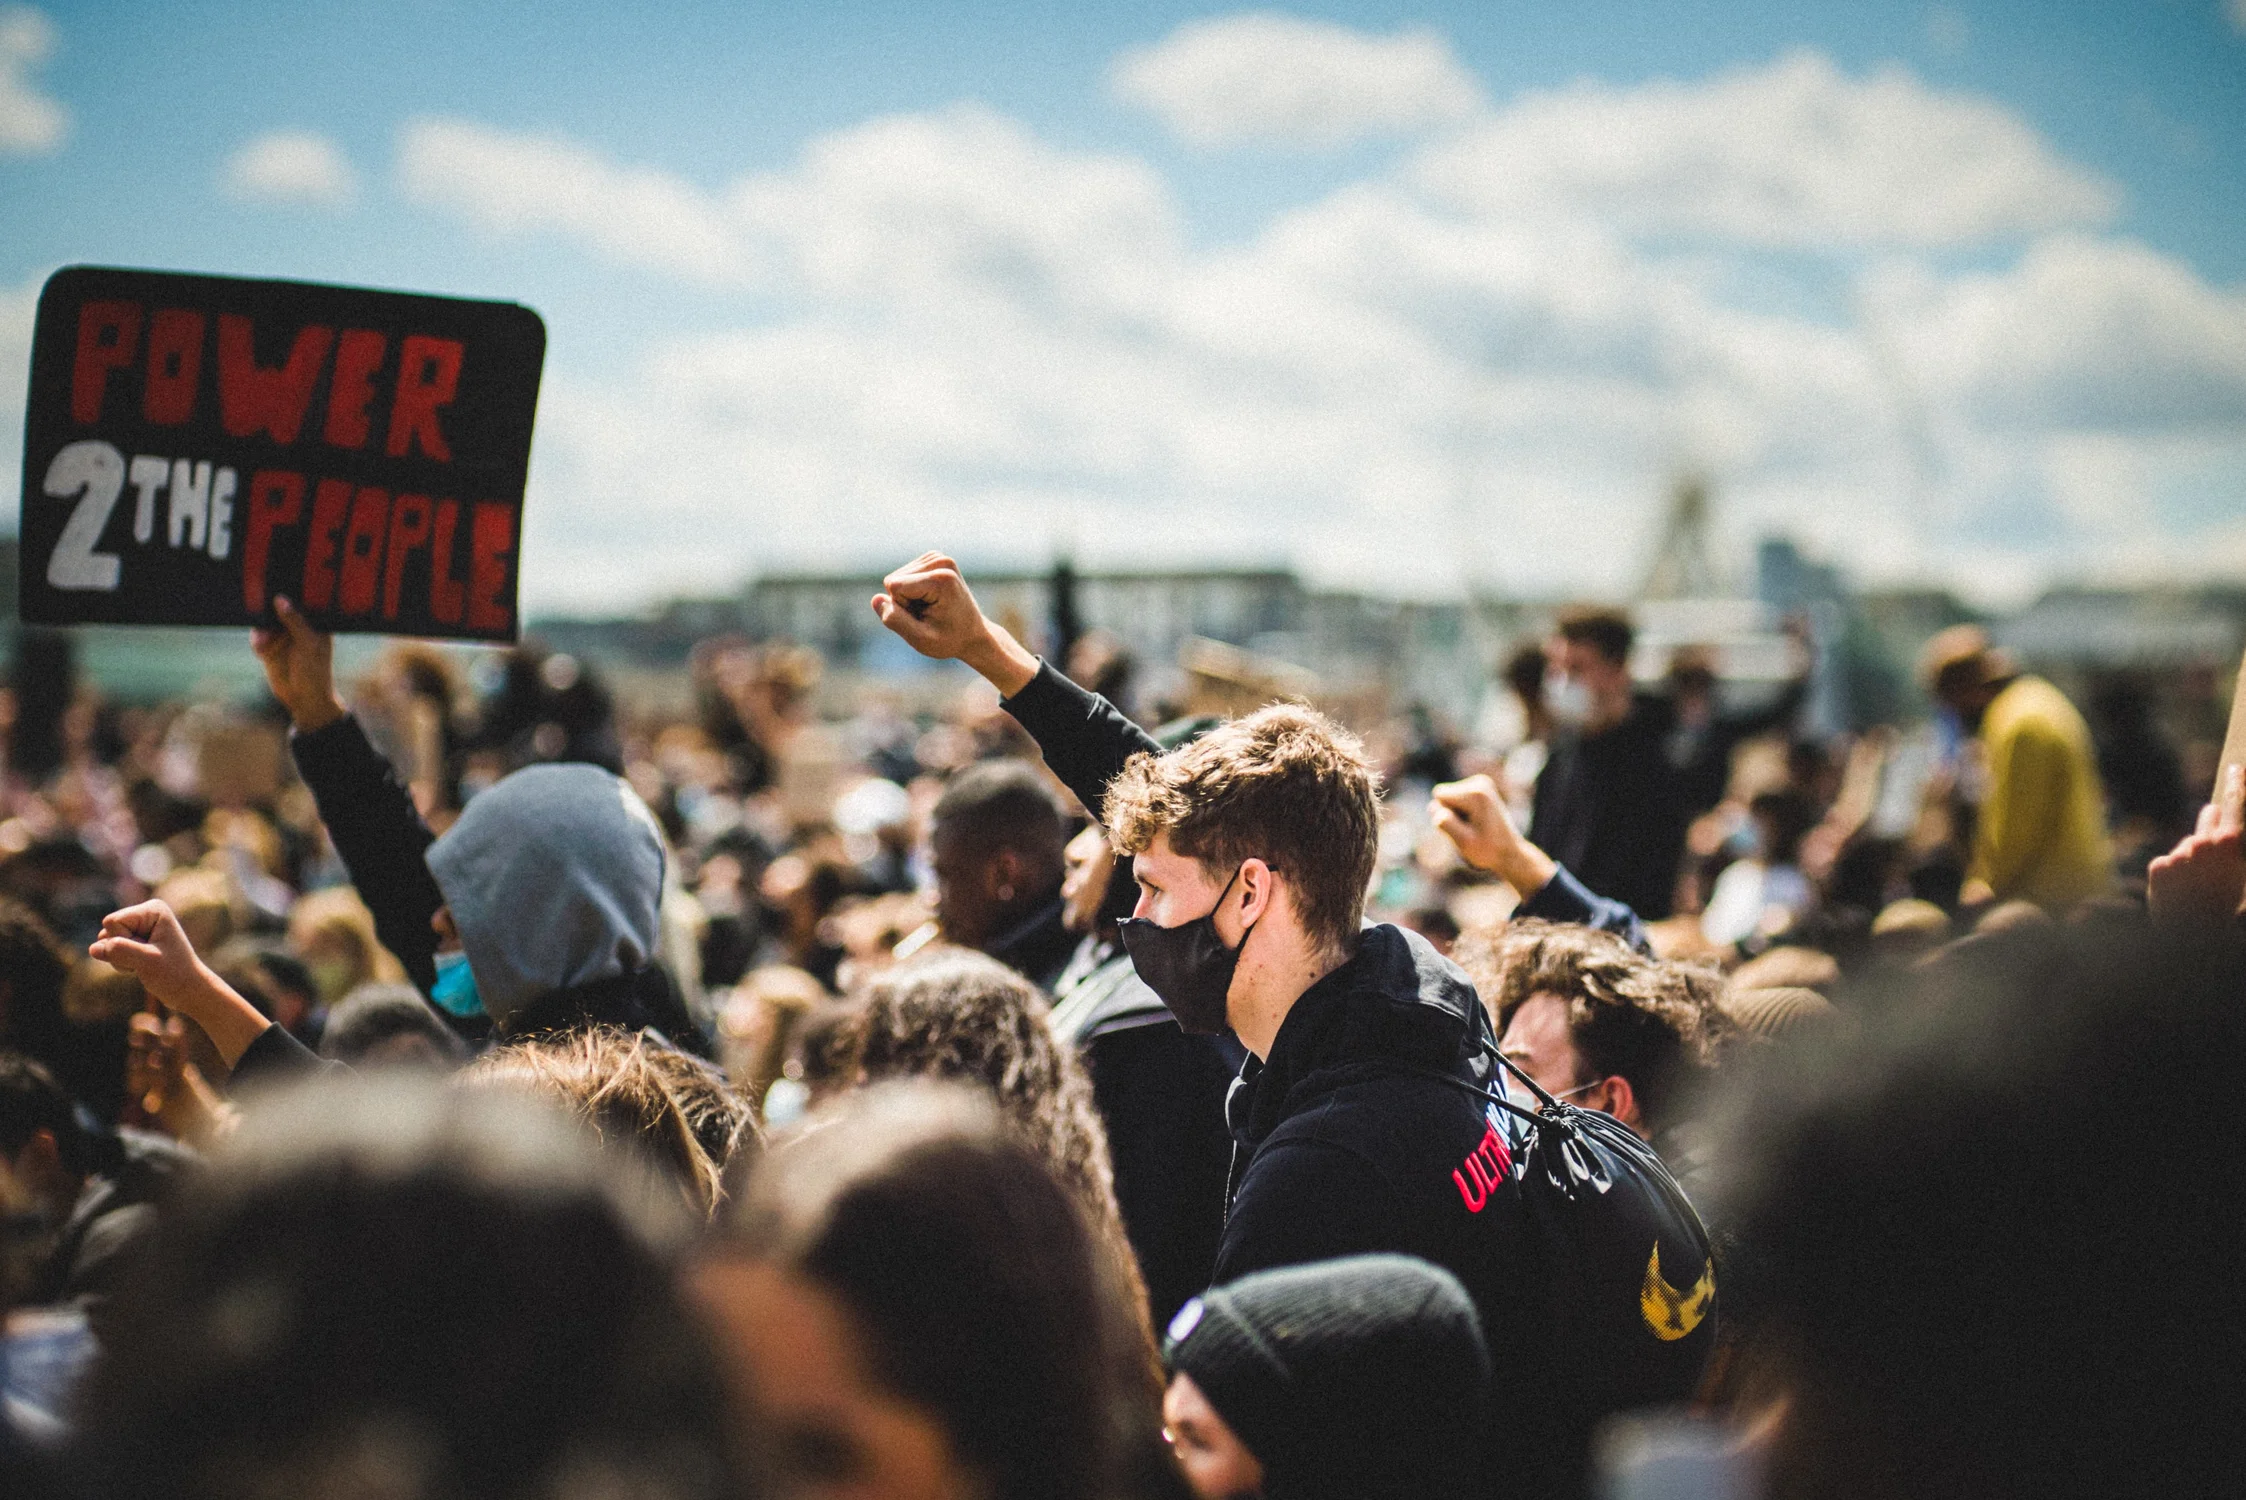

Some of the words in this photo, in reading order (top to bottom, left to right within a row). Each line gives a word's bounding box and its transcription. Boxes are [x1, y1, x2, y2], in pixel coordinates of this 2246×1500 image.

[71, 300, 465, 464] POWER
[42, 439, 125, 592] 2
[129, 454, 238, 560] THE
[242, 469, 514, 631] PEOPLE
